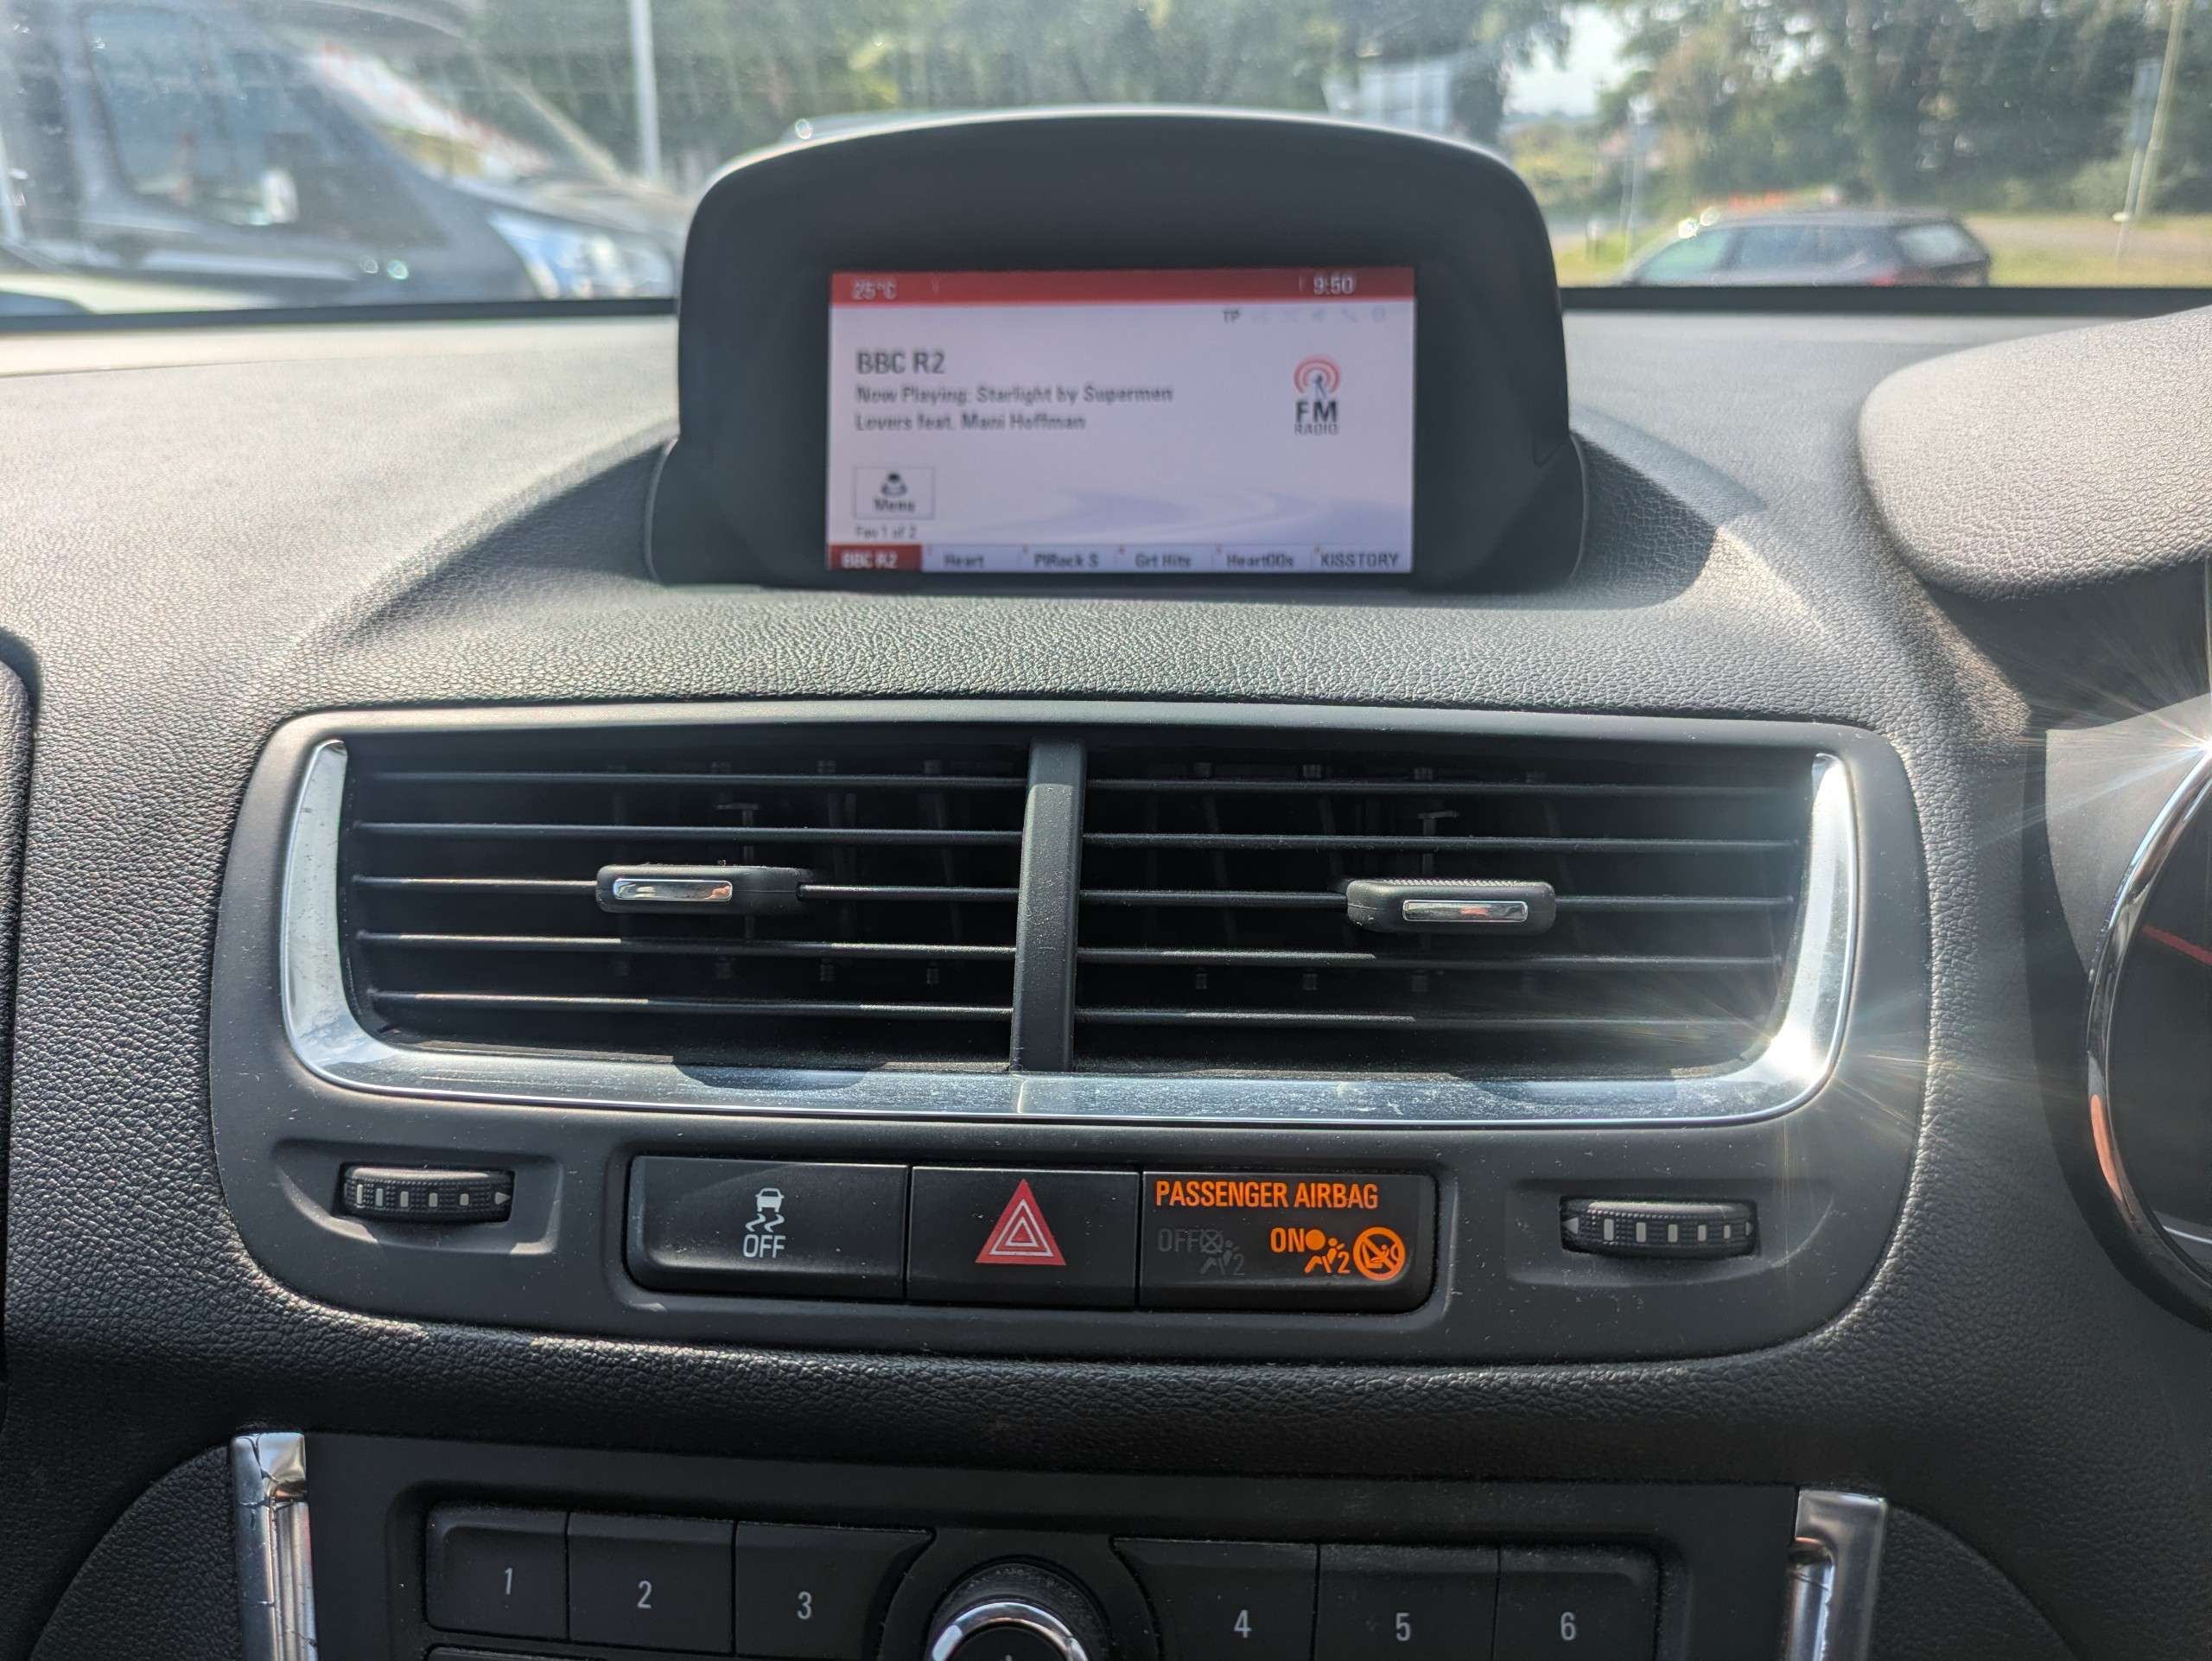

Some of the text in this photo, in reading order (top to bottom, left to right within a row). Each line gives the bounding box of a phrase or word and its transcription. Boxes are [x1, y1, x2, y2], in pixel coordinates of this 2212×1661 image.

[1313, 276, 1356, 296] 9:50
[1223, 309, 1241, 322] TP
[855, 350, 945, 374] BBC R2
[855, 386, 897, 403] Now
[976, 384, 1052, 406] Starlight
[1056, 384, 1077, 405] by
[1083, 383, 1173, 405] Supermen
[855, 413, 912, 431] Lovers
[961, 413, 1006, 430] Mani
[1009, 411, 1086, 430] Hoffman
[1295, 401, 1338, 423] FM
[1294, 423, 1338, 436] RADIO
[874, 497, 915, 512] Menu
[842, 551, 872, 569] BBC
[943, 554, 984, 568] Heart
[1320, 552, 1400, 567] KISSTORY
[1155, 1181, 1379, 1209] PASSENGER AIRBAG
[743, 1234, 786, 1258] OFF
[1157, 1228, 1200, 1252] OFF
[1270, 1227, 1305, 1252] ON
[504, 1568, 514, 1595] 1
[637, 1581, 652, 1609] 2
[797, 1591, 812, 1620] 3
[1233, 1610, 1252, 1639] 4
[1395, 1613, 1412, 1641] 5
[1559, 1611, 1576, 1640] 6
